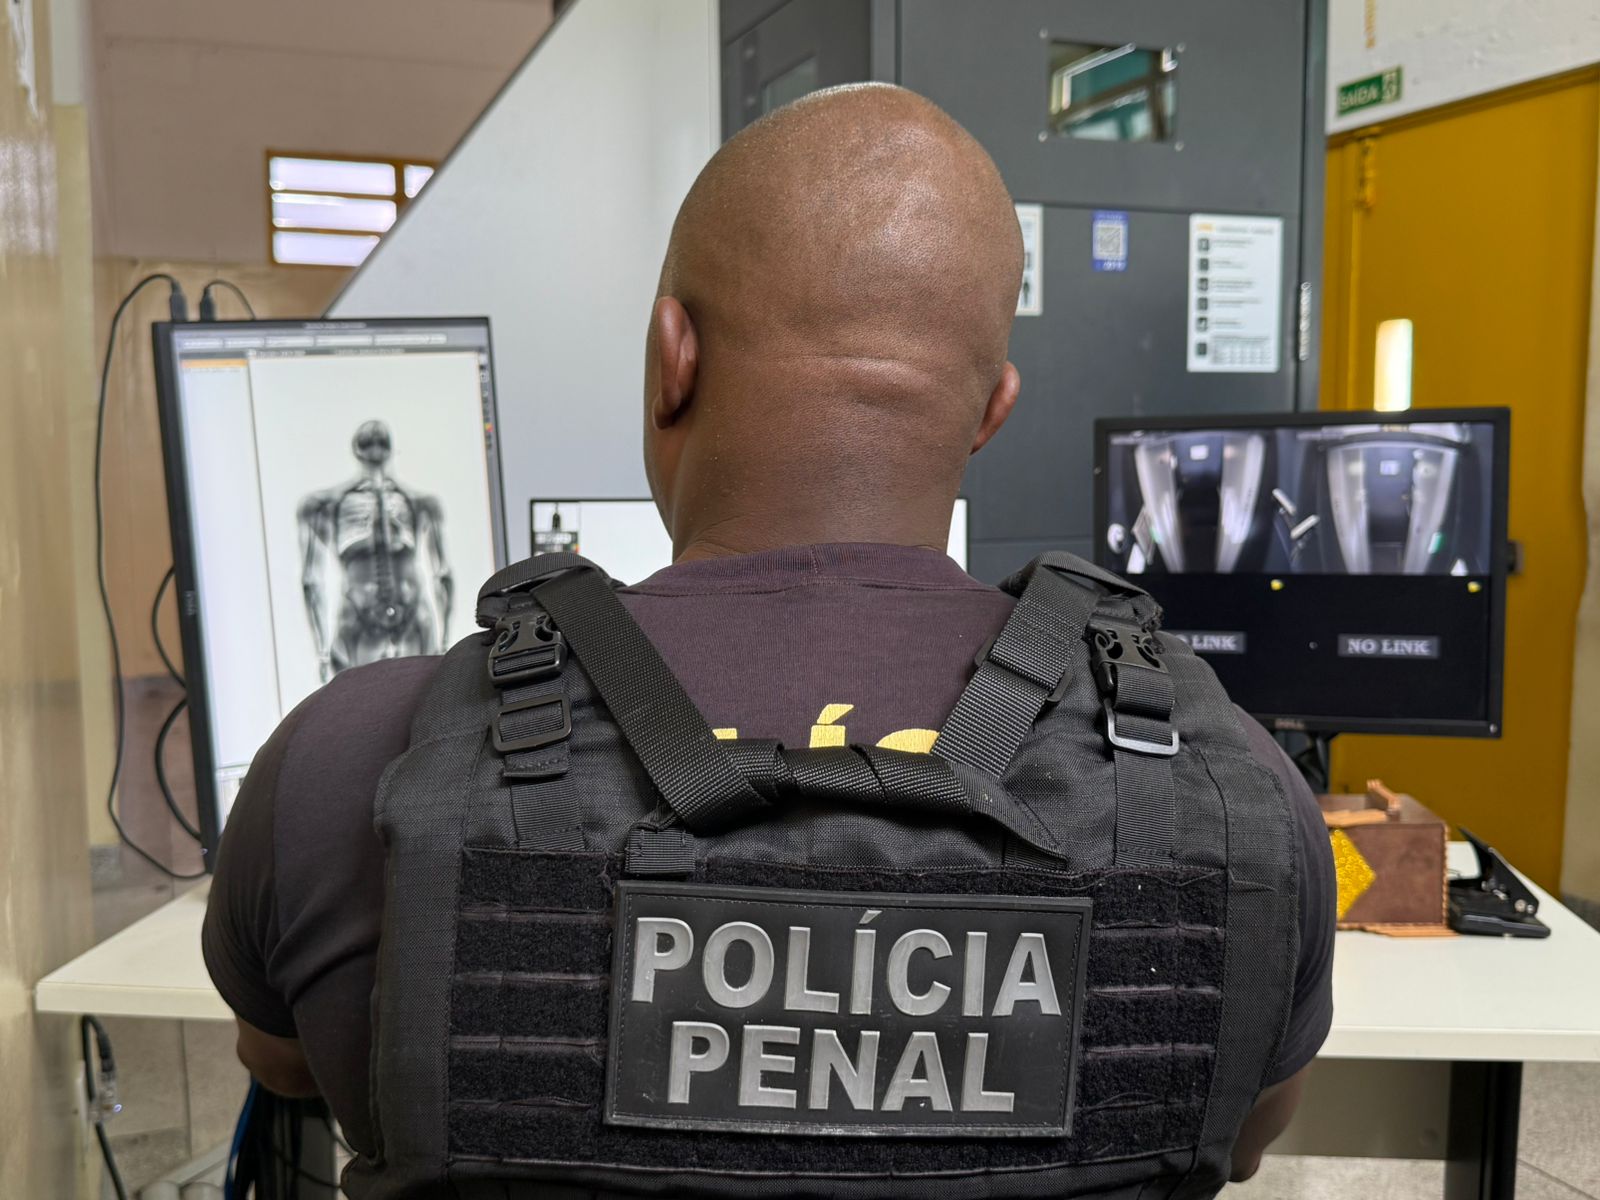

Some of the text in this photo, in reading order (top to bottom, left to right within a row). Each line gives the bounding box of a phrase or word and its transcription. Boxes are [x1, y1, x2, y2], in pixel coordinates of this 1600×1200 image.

[1192, 634, 1236, 650] LINK
[1347, 637, 1431, 655] NO LINK
[630, 910, 1062, 1018] POLÍCIA
[666, 1021, 1016, 1112] PENAL
